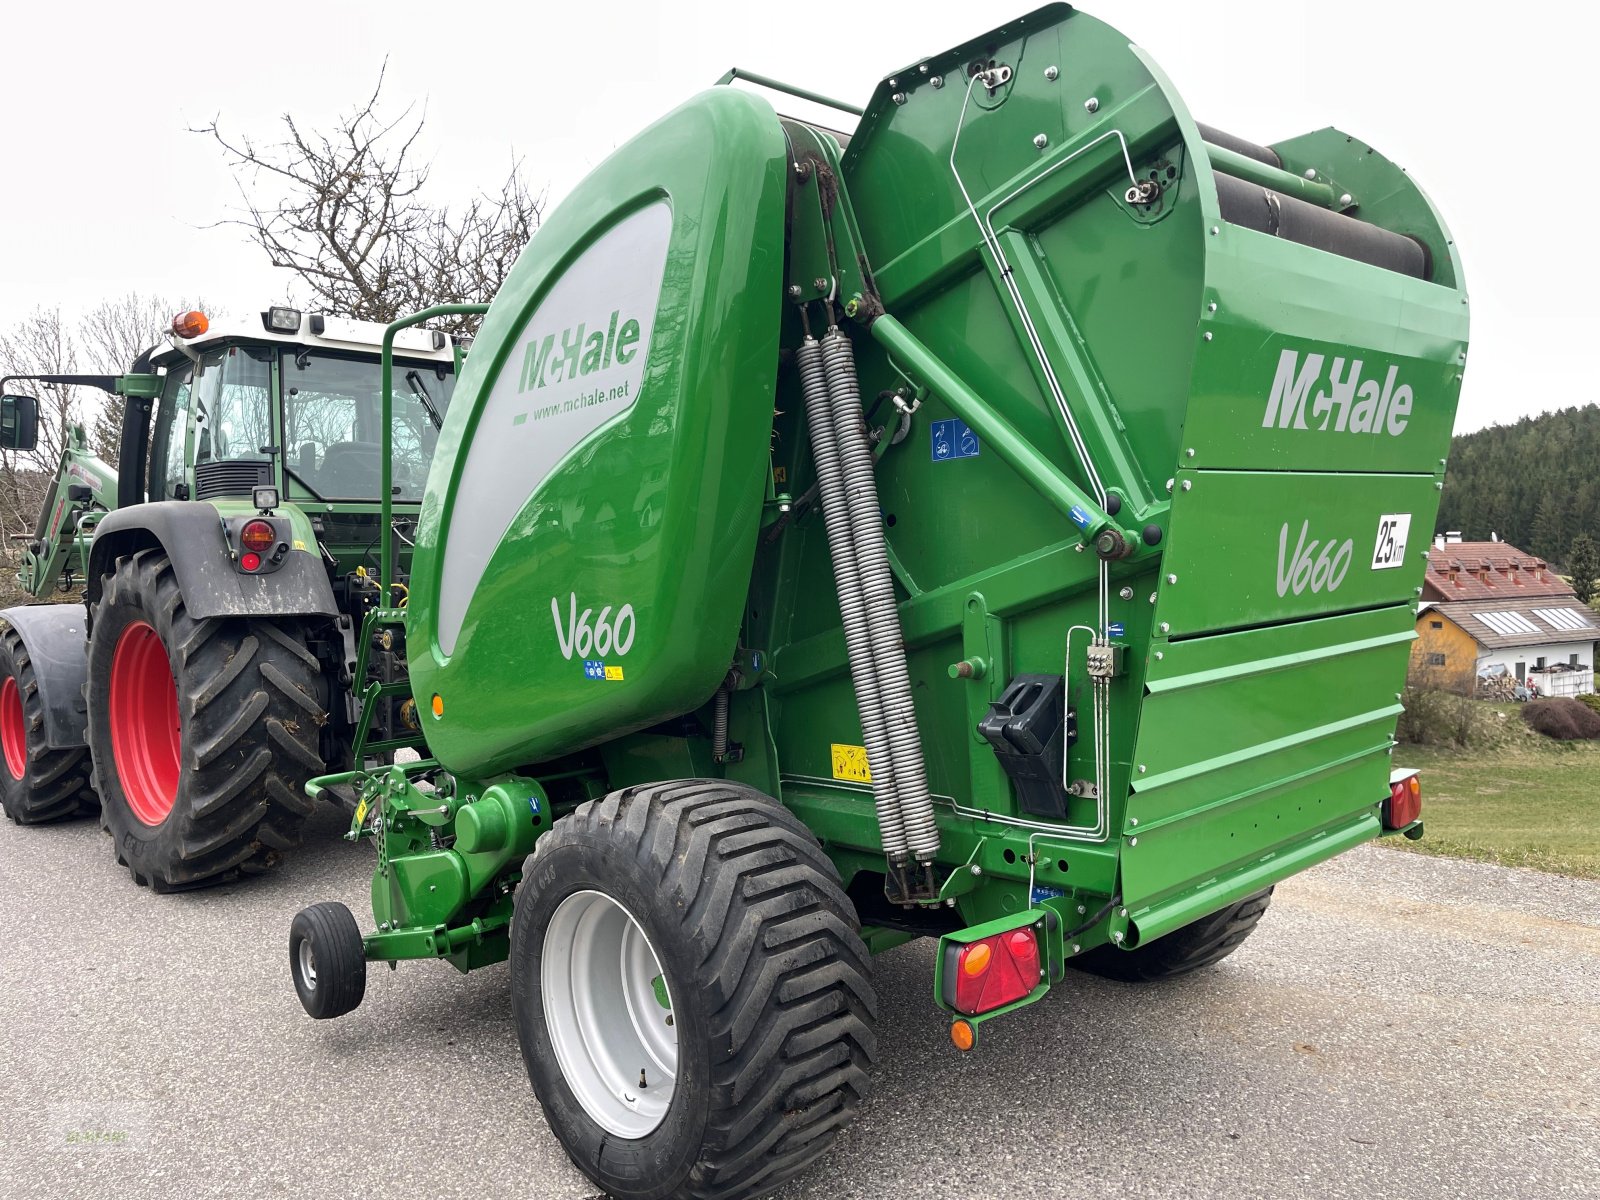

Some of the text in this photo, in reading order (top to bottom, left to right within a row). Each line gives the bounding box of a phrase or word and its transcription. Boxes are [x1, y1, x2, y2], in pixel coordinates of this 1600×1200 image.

[518, 310, 640, 394] McHale
[533, 380, 629, 421] www.mchale.net
[1262, 349, 1413, 436] McHale
[1277, 519, 1353, 597] V660
[1375, 521, 1397, 563] 25
[551, 592, 635, 660] V660
